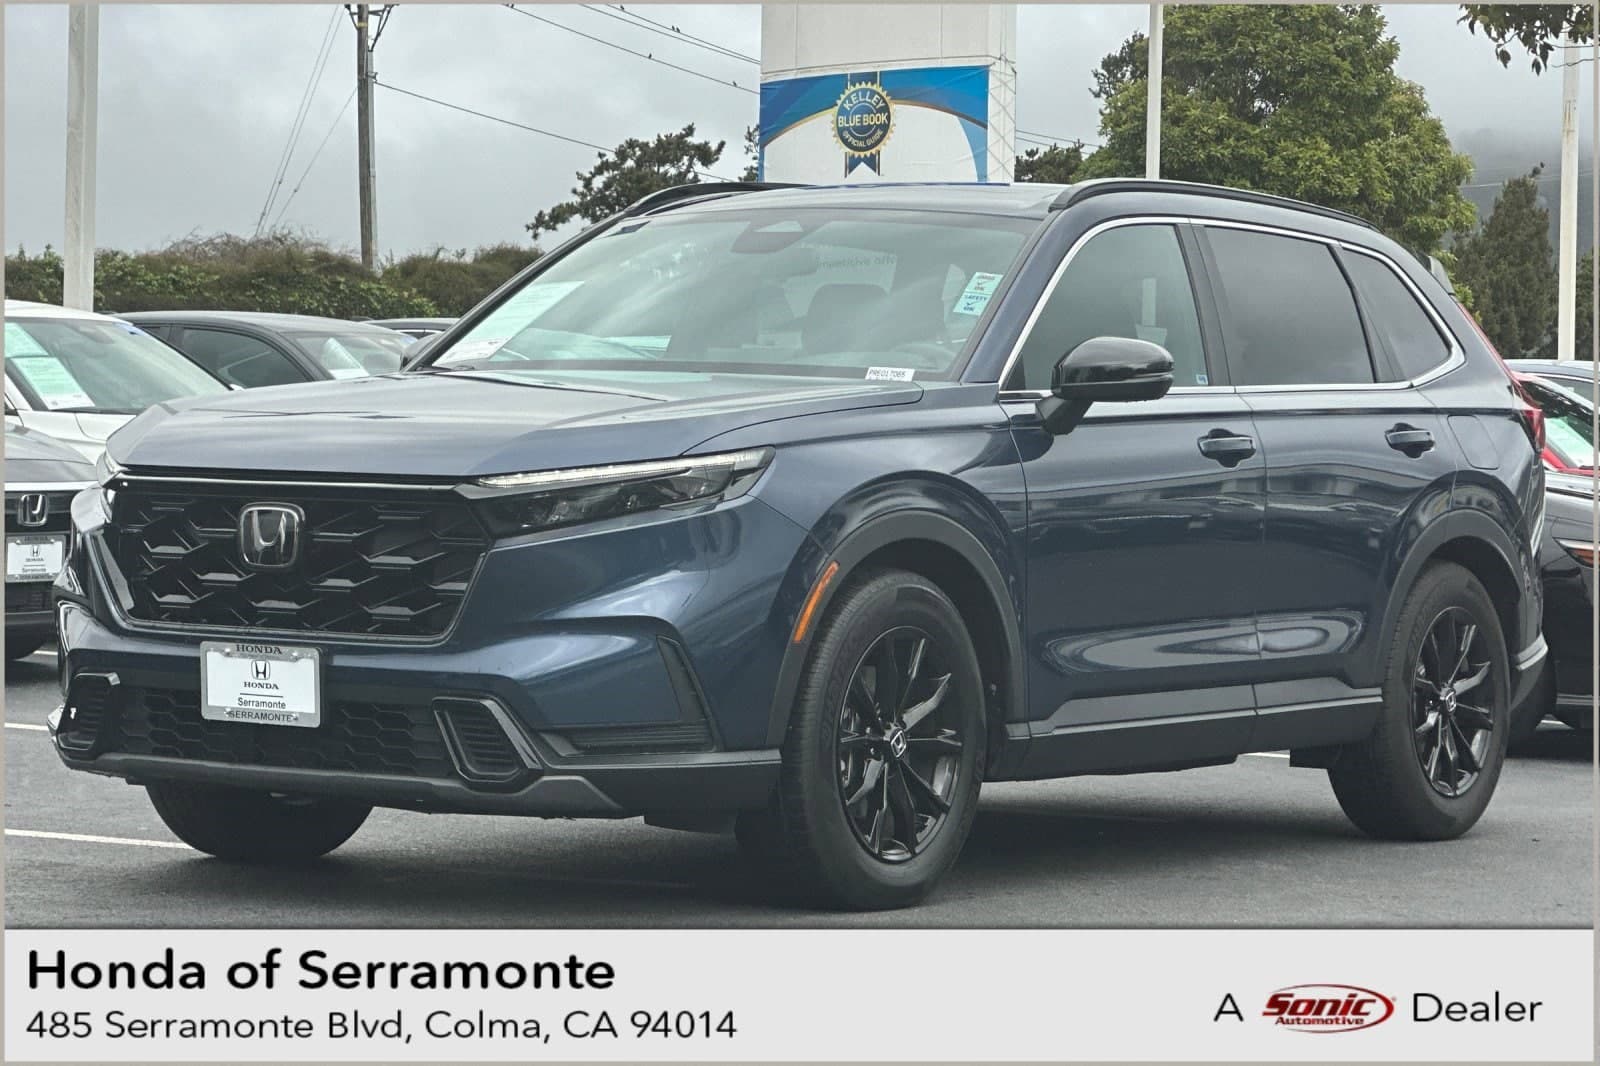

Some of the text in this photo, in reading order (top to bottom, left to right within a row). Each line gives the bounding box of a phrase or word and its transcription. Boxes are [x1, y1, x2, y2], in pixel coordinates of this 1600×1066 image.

[843, 91, 885, 110] KELLEY
[838, 112, 888, 127] BLUE BOOK
[842, 131, 866, 147] OFFICIAL
[235, 644, 283, 655] HONDA
[243, 681, 280, 690] HONDA
[237, 697, 287, 710] Serramonte
[228, 710, 293, 722] SERRAMONTE
